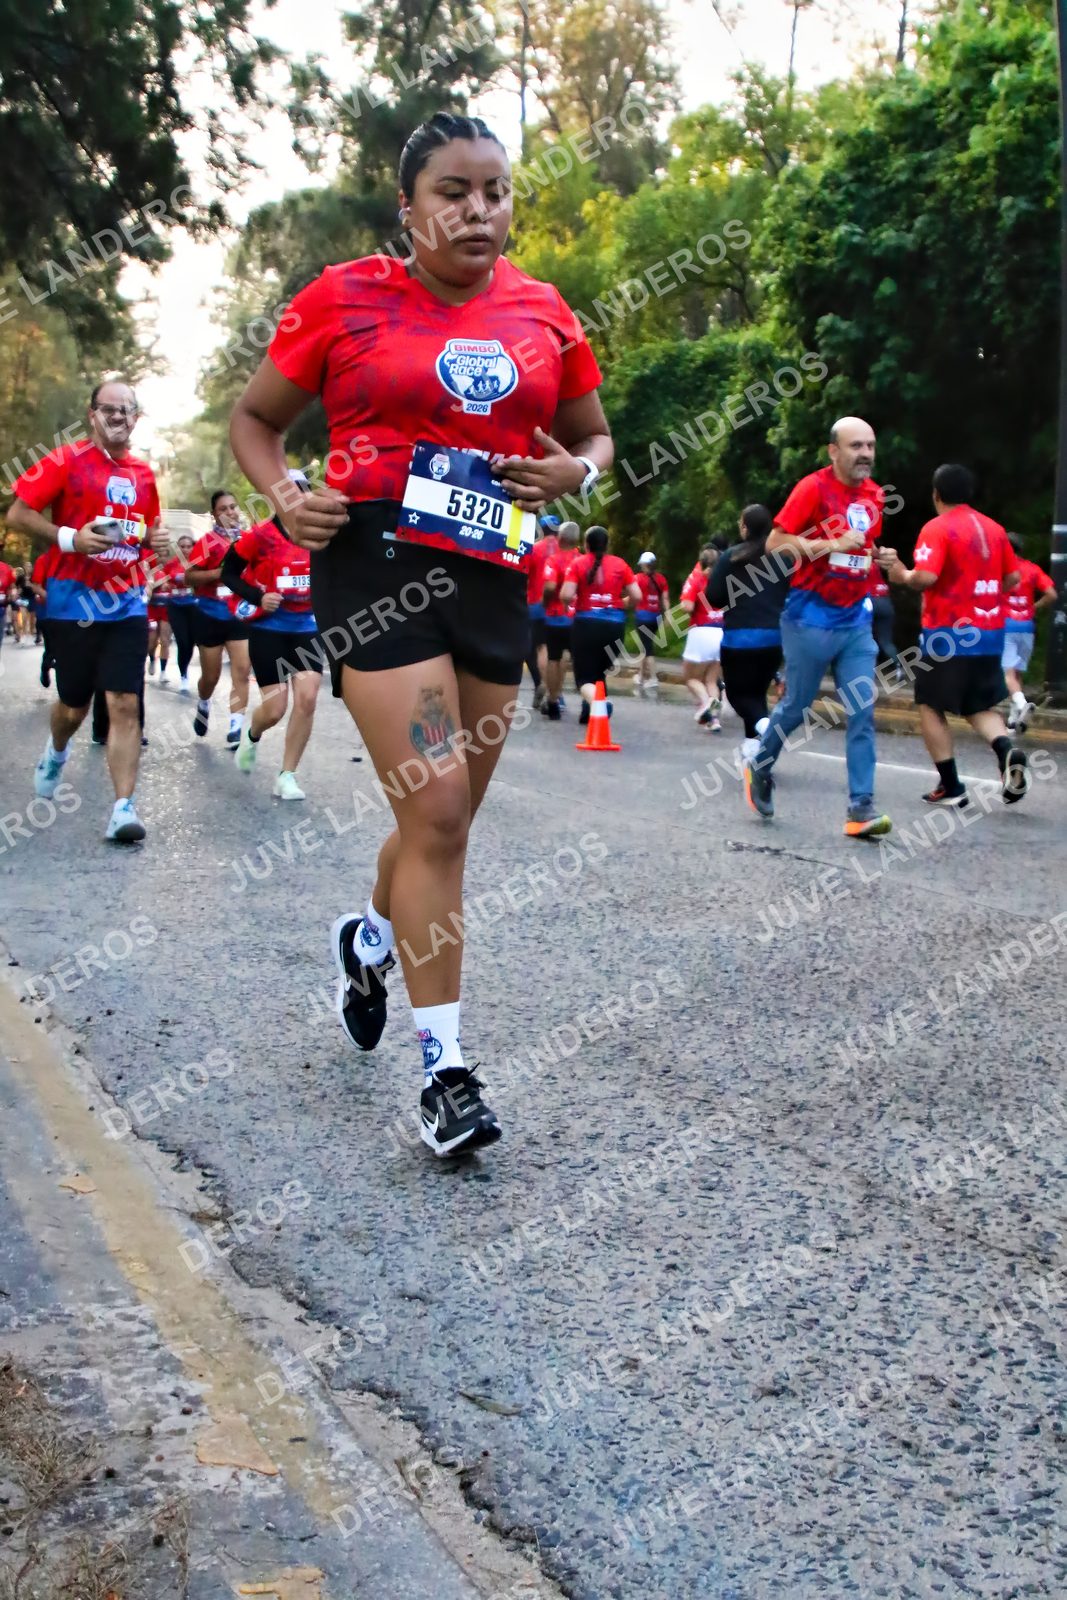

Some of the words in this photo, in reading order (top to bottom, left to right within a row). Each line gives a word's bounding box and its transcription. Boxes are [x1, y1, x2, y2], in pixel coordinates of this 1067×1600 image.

[454, 344, 496, 353] BIMBO
[456, 355, 497, 368] Global
[449, 364, 482, 376] Race
[466, 403, 489, 413] 2026
[447, 489, 505, 530] 5320
[502, 552, 521, 565] 10K
